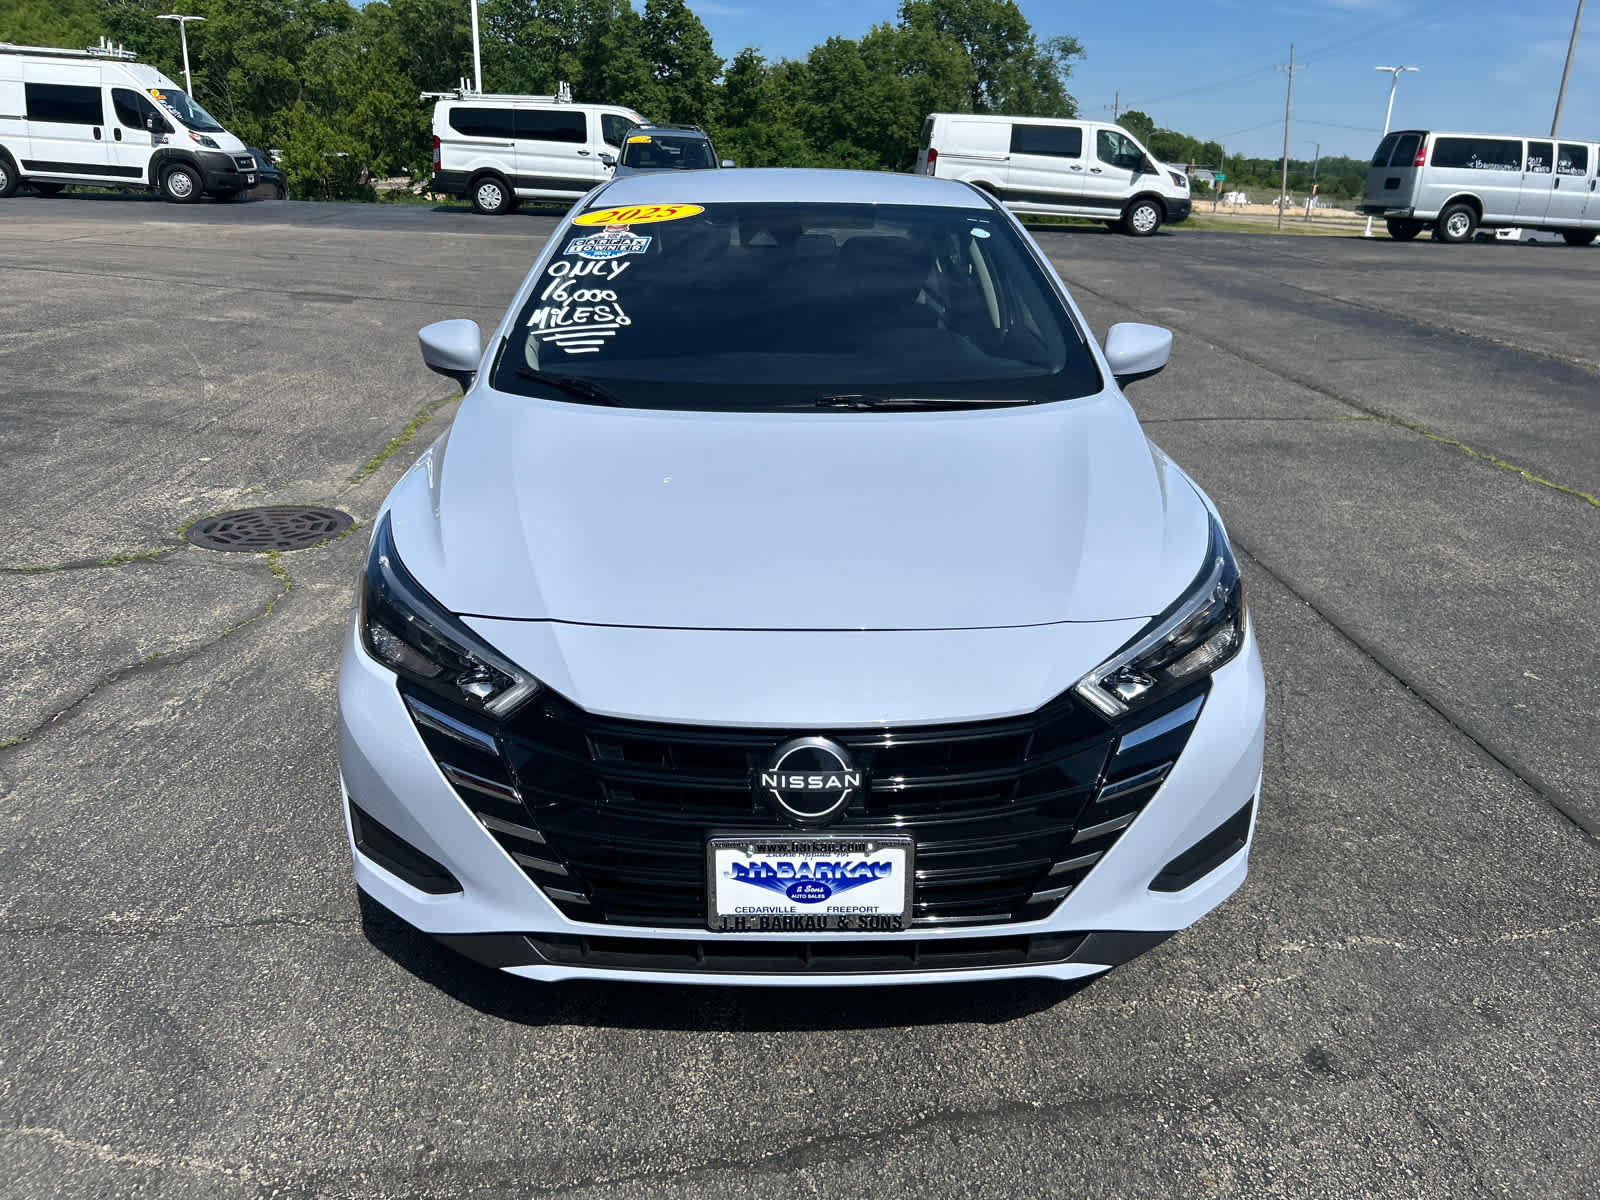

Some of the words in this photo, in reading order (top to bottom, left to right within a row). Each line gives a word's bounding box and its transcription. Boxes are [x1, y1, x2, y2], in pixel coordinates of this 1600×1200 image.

[594, 205, 685, 223] 2025
[575, 239, 645, 247] CARFAX
[548, 260, 631, 281] ONLY
[541, 278, 618, 306] 16,000
[761, 773, 860, 789] NISSAN
[756, 841, 866, 853] www.barkau.com
[804, 885, 825, 893] Sons
[735, 906, 797, 914] CEDARVILLE
[760, 916, 828, 930] BARKAU
[838, 916, 849, 929] &
[858, 916, 903, 929] SONS
